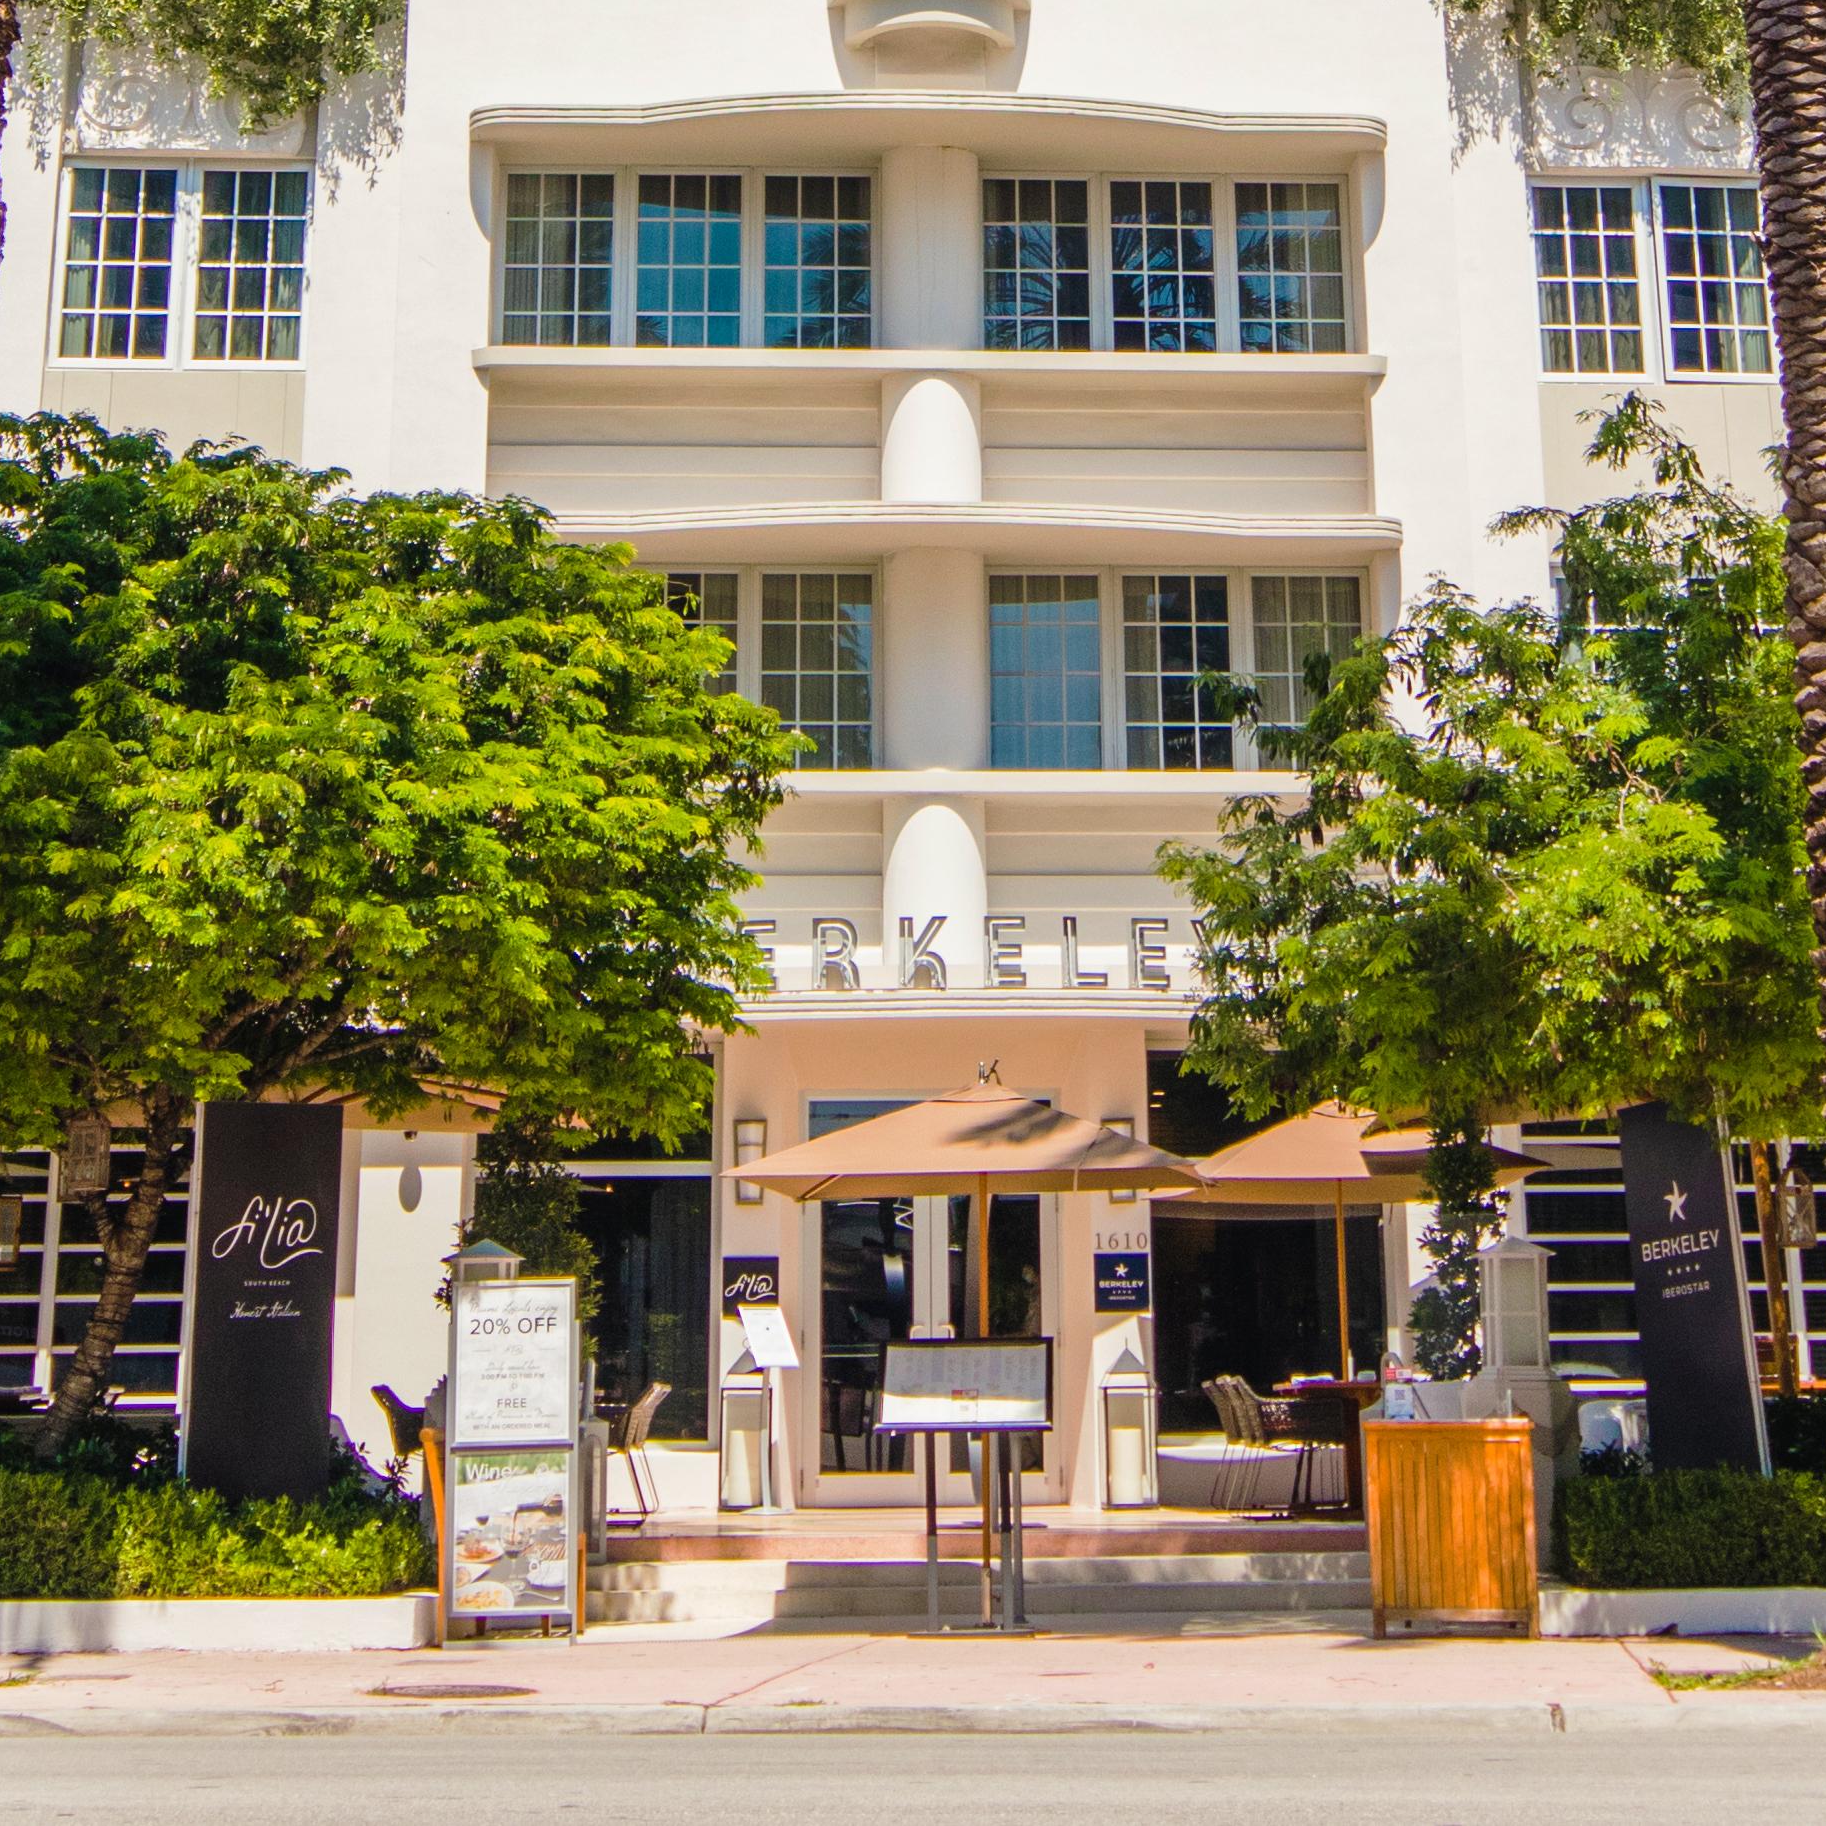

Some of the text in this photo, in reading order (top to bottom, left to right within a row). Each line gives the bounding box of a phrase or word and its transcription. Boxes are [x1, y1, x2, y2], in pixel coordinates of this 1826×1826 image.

[1095, 1232, 1148, 1250] 1610
[1641, 1229, 1720, 1262] BERKELEY
[1099, 1280, 1144, 1289] BERKELEY
[1661, 1281, 1711, 1299] IBEROSTAR
[470, 1317, 558, 1335] 20% OFF
[497, 1398, 527, 1408] FREE
